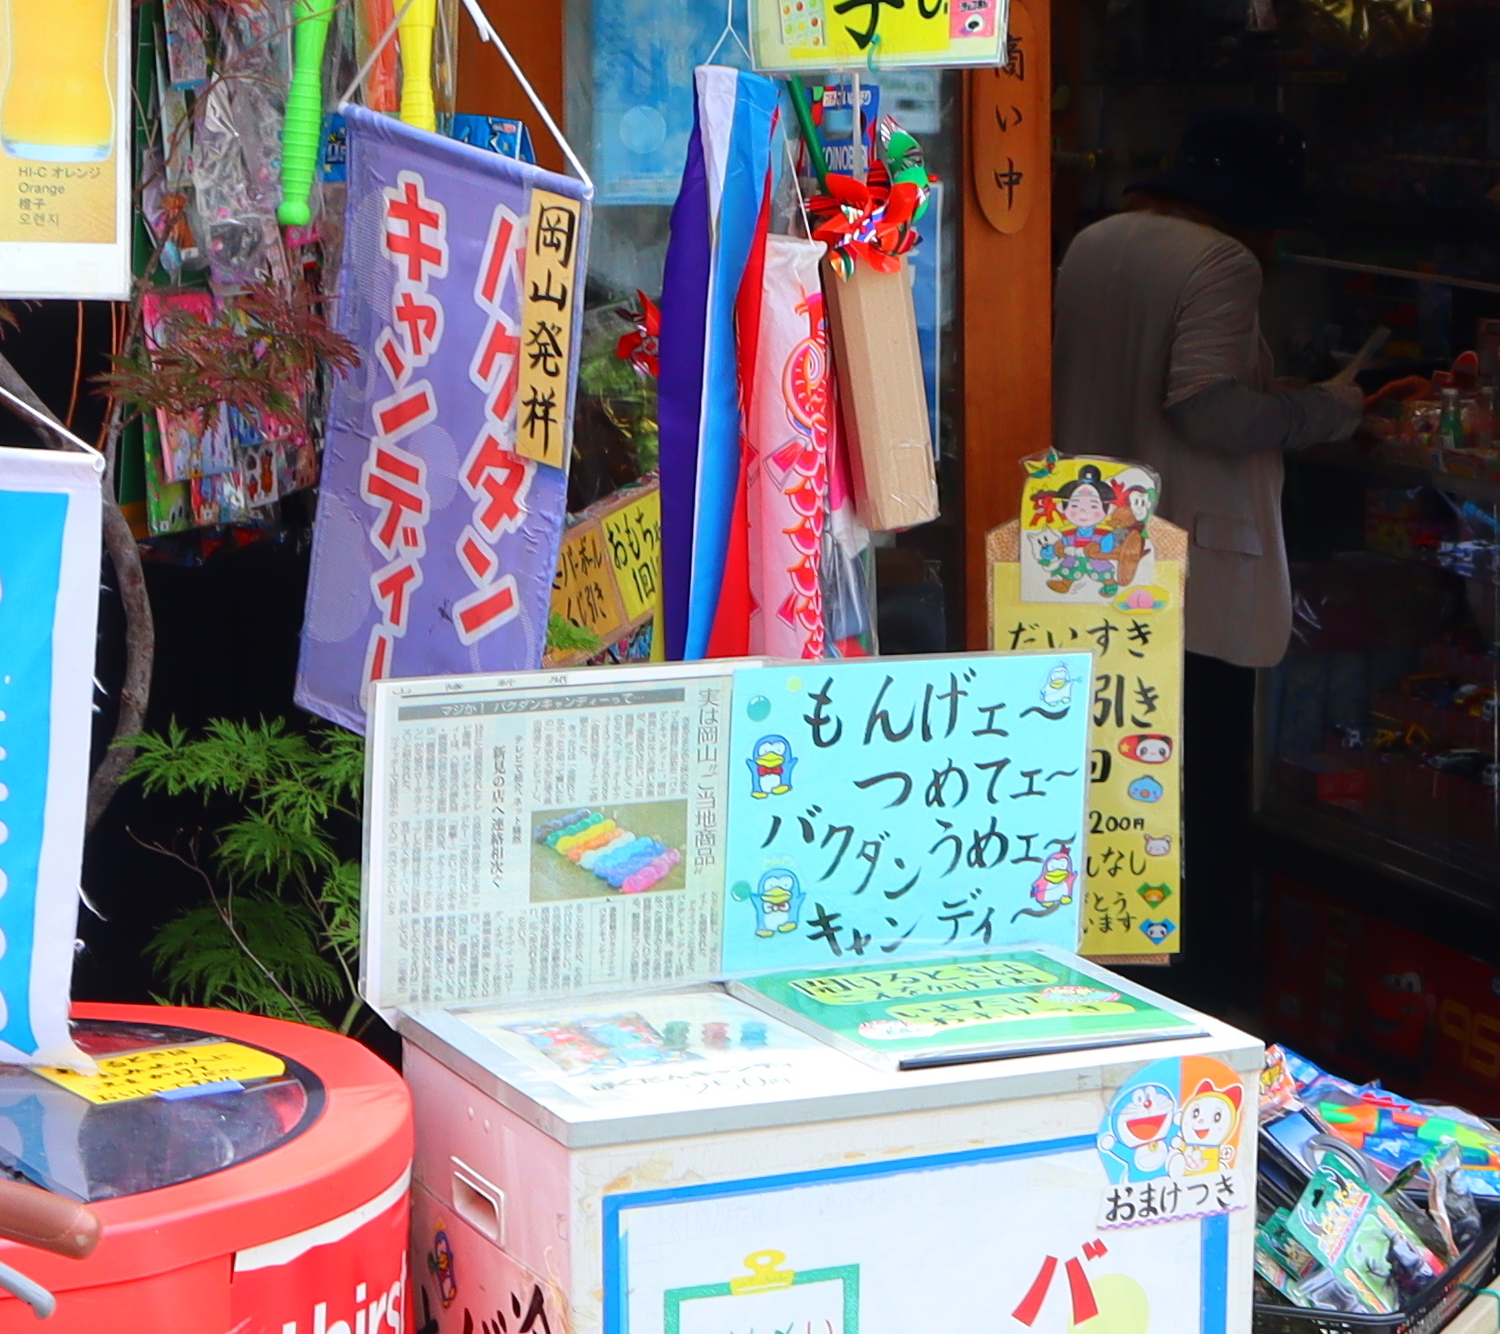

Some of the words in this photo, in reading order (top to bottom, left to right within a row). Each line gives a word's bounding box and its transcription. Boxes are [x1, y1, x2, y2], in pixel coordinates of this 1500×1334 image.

[19, 166, 48, 178] HI-C
[51, 167, 101, 180] オレンジ
[19, 181, 65, 196] Orange
[521, 202, 577, 457] 岡山発祥
[761, 805, 922, 900] バクダン
[1103, 1176, 1240, 1225] おまけつき
